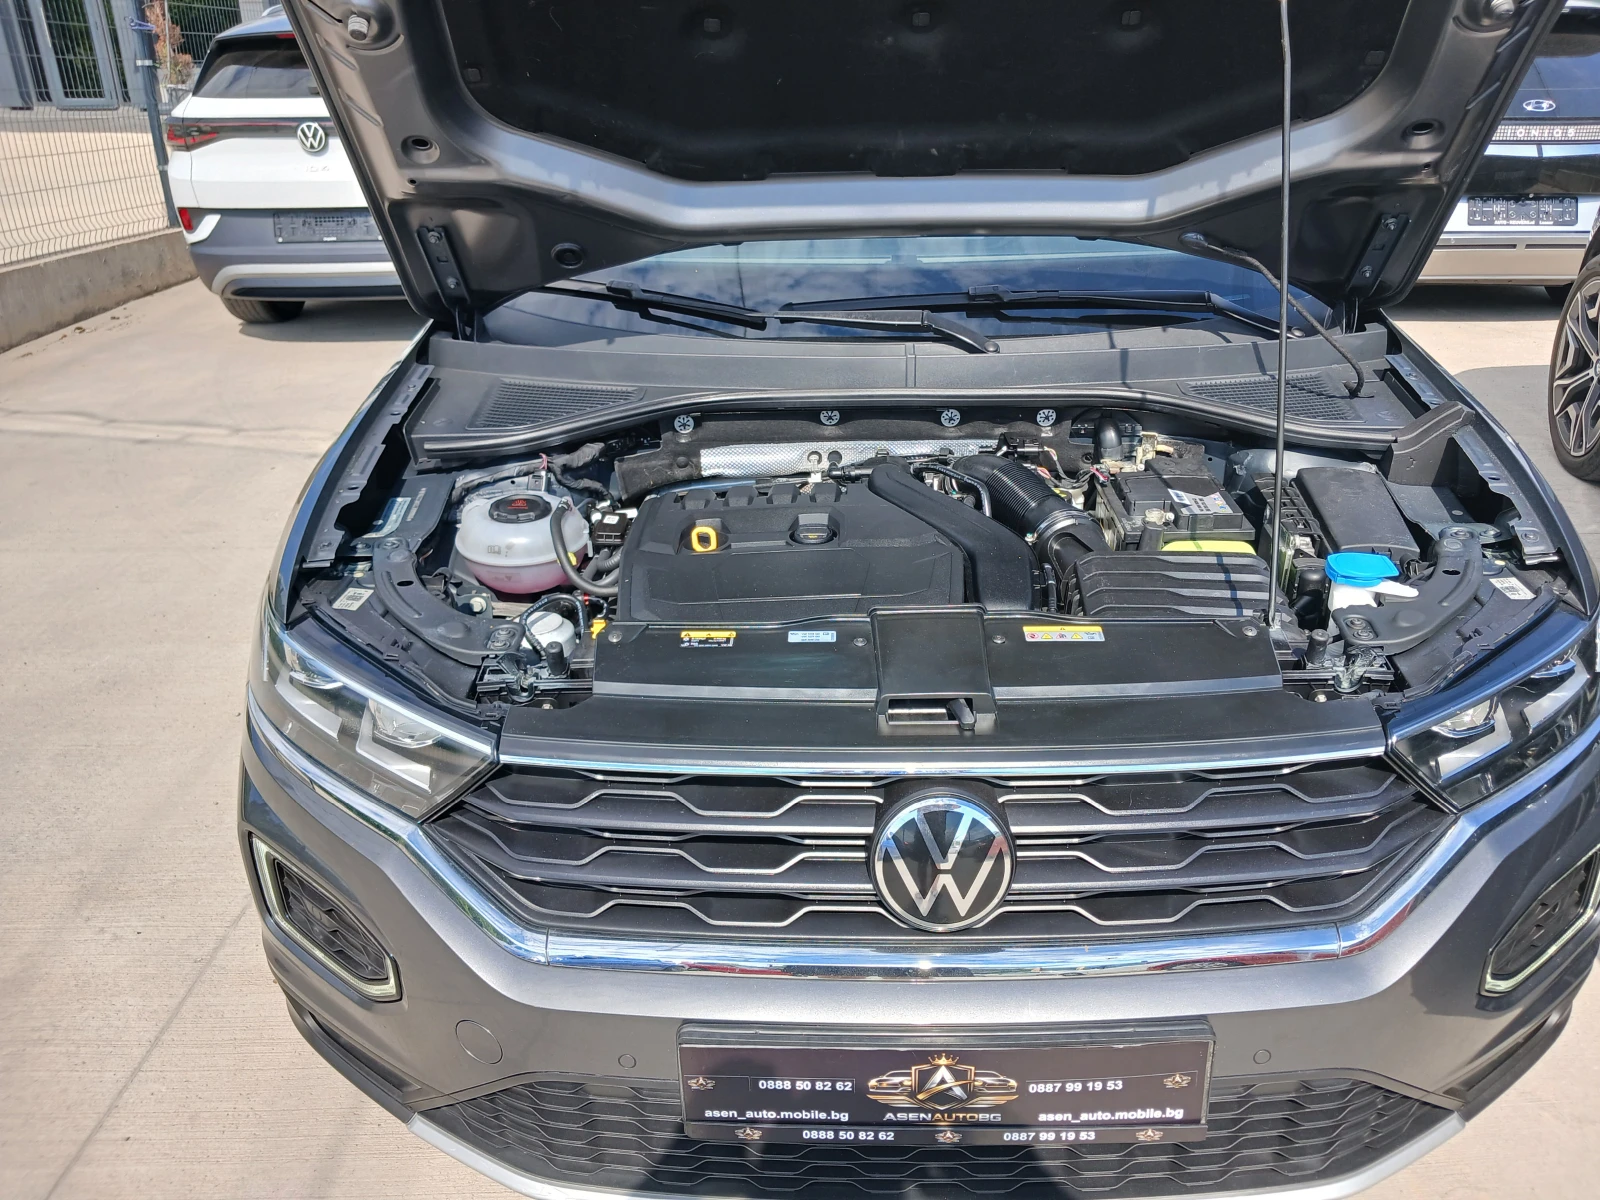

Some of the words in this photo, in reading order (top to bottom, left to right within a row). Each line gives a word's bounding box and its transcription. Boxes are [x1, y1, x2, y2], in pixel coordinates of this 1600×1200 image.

[298, 122, 325, 151] VW
[880, 802, 1008, 921] VW
[758, 1080, 792, 1090] 0888
[795, 1080, 812, 1091] 50
[815, 1081, 832, 1091] 82
[835, 1081, 853, 1091] 62
[1028, 1083, 1062, 1093] 0887
[1065, 1082, 1083, 1093] 99
[1086, 1081, 1103, 1092] 19
[1106, 1080, 1123, 1091] 53
[704, 1109, 849, 1121] asen_auto.mobile.bg
[882, 1112, 1002, 1122] ASENAUTOBG
[1038, 1108, 1184, 1123] asen_auto.mobile.bg
[802, 1130, 835, 1140] 0888
[838, 1131, 855, 1140] 50
[858, 1131, 875, 1140] 82
[878, 1131, 895, 1141] 62
[1003, 1132, 1036, 1141] 0887
[1039, 1132, 1056, 1141] 99
[1059, 1132, 1076, 1141] 19
[1079, 1131, 1096, 1140] 53
